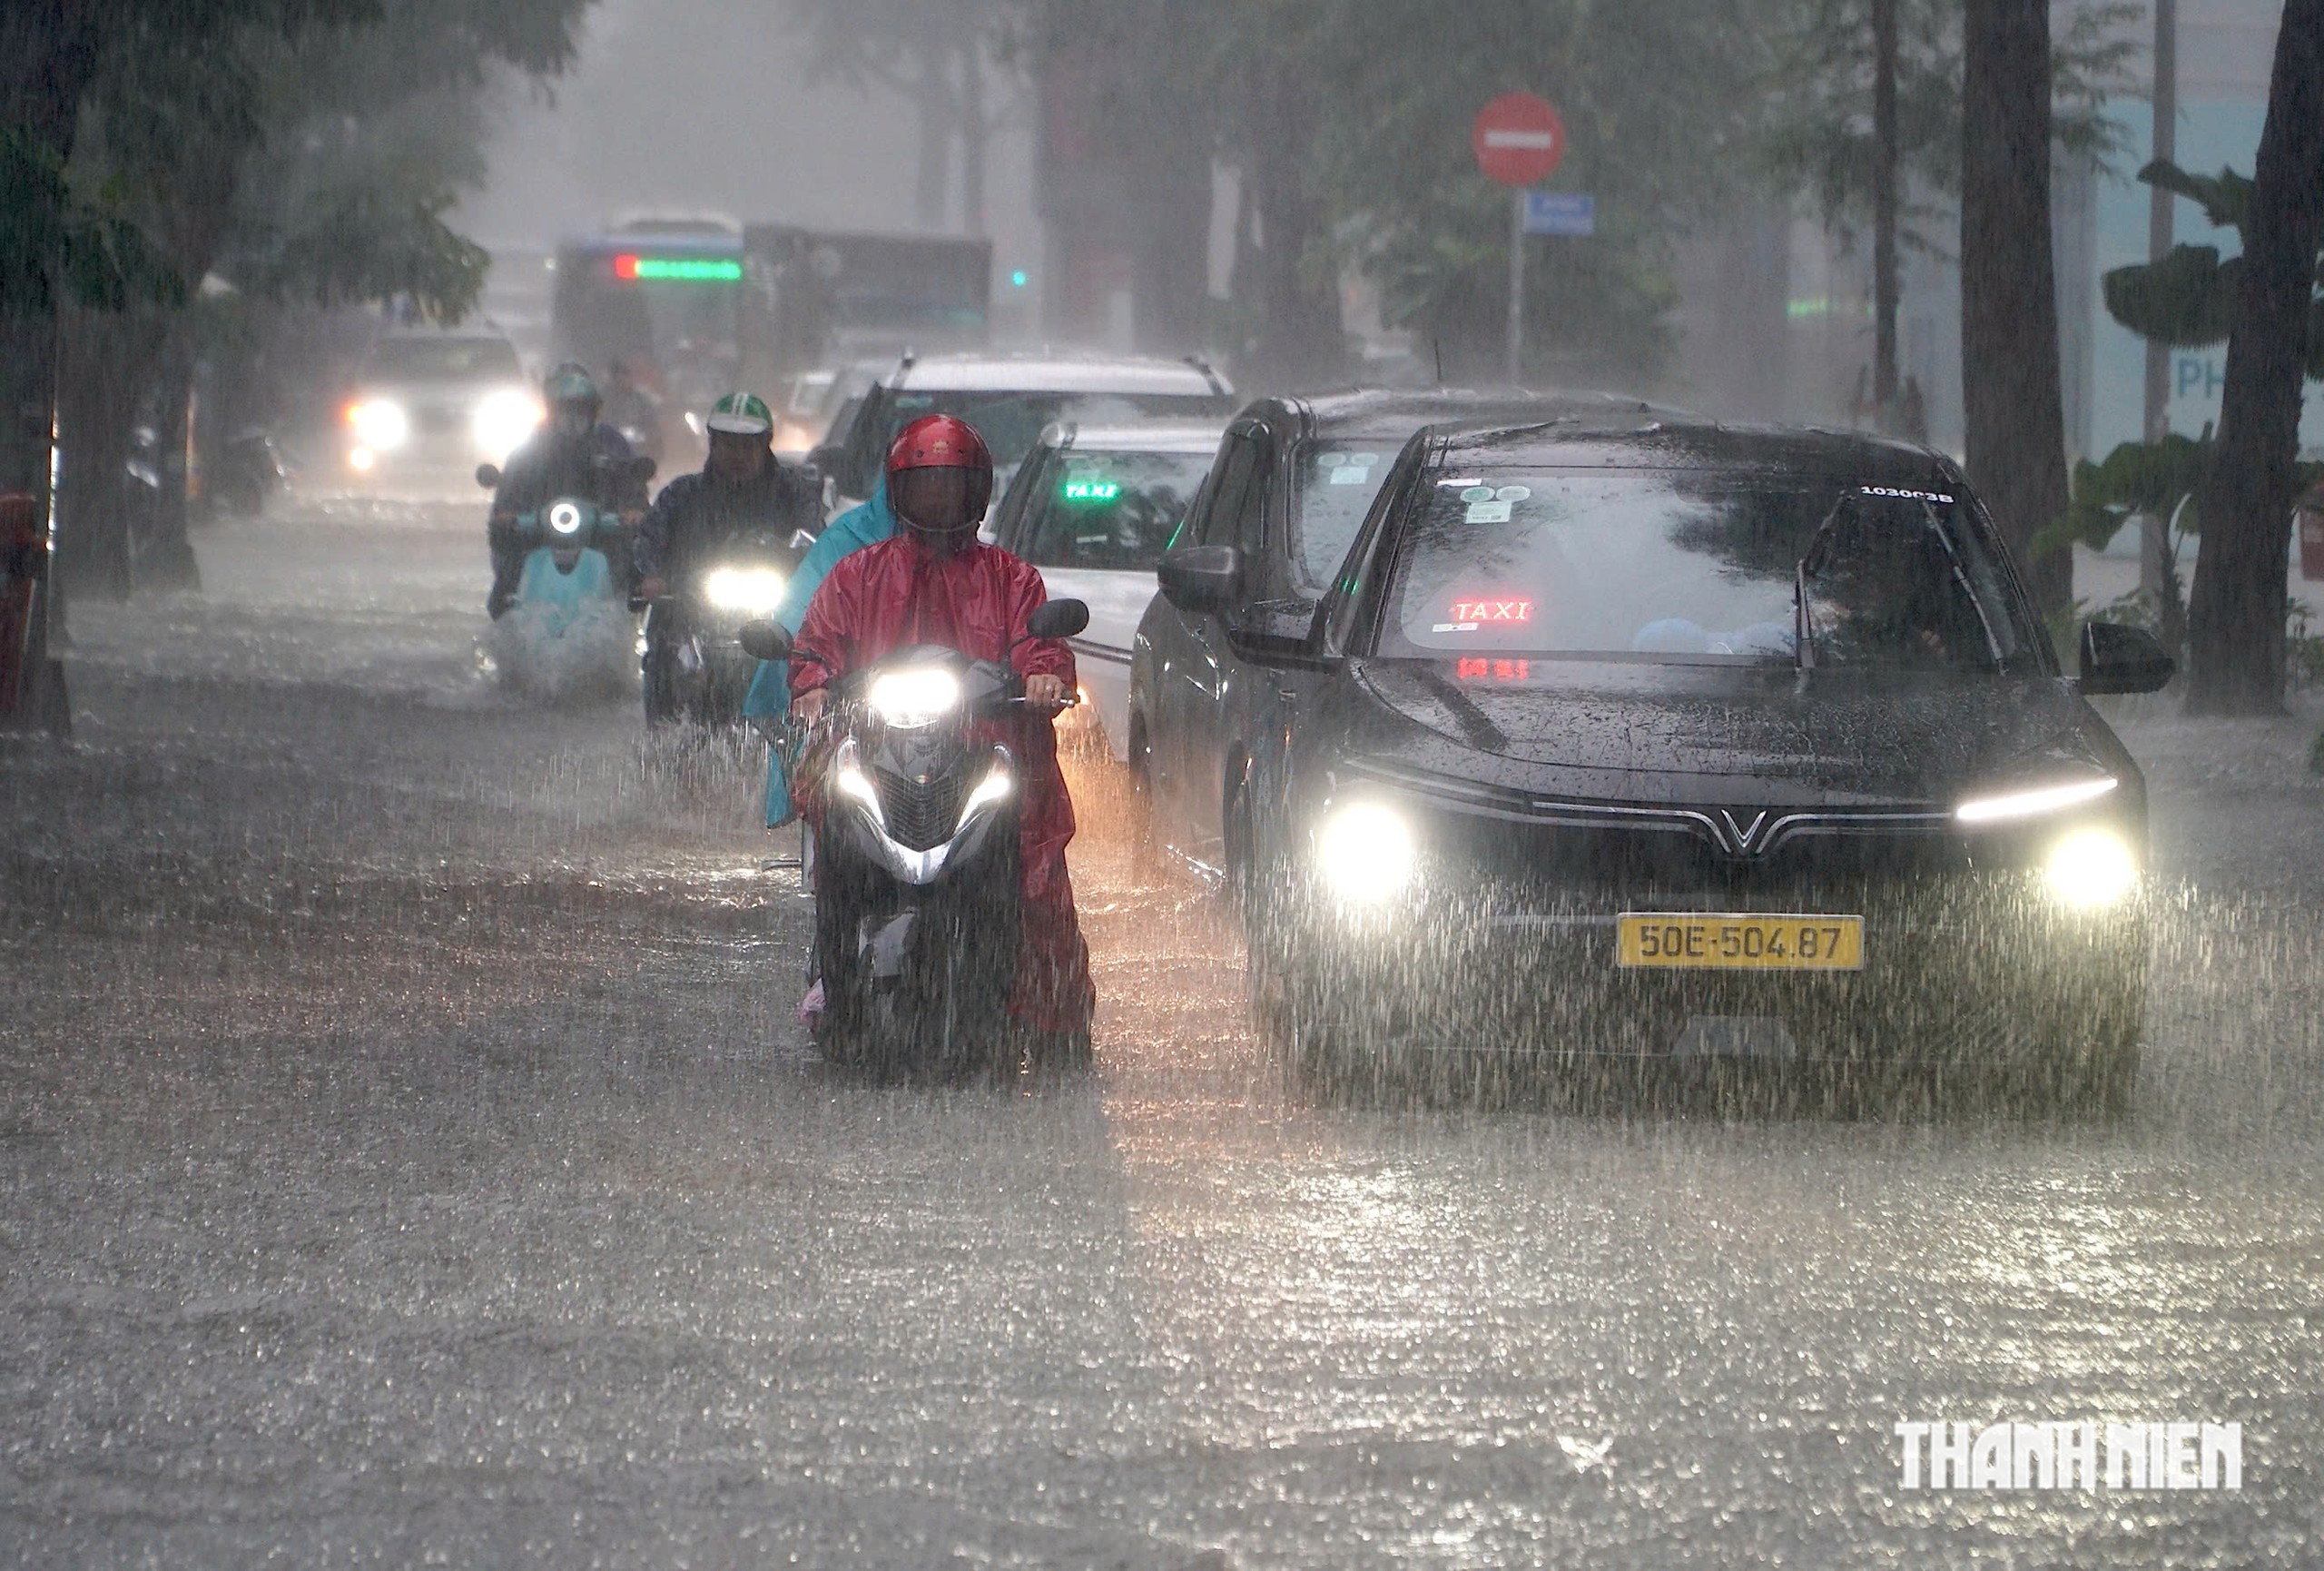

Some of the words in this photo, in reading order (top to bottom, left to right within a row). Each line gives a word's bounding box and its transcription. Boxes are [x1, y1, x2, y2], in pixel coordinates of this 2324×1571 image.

[1065, 483, 1118, 499] TAXI
[1455, 601, 1530, 620] TAXI
[1640, 924, 1842, 959] 50E-504.87
